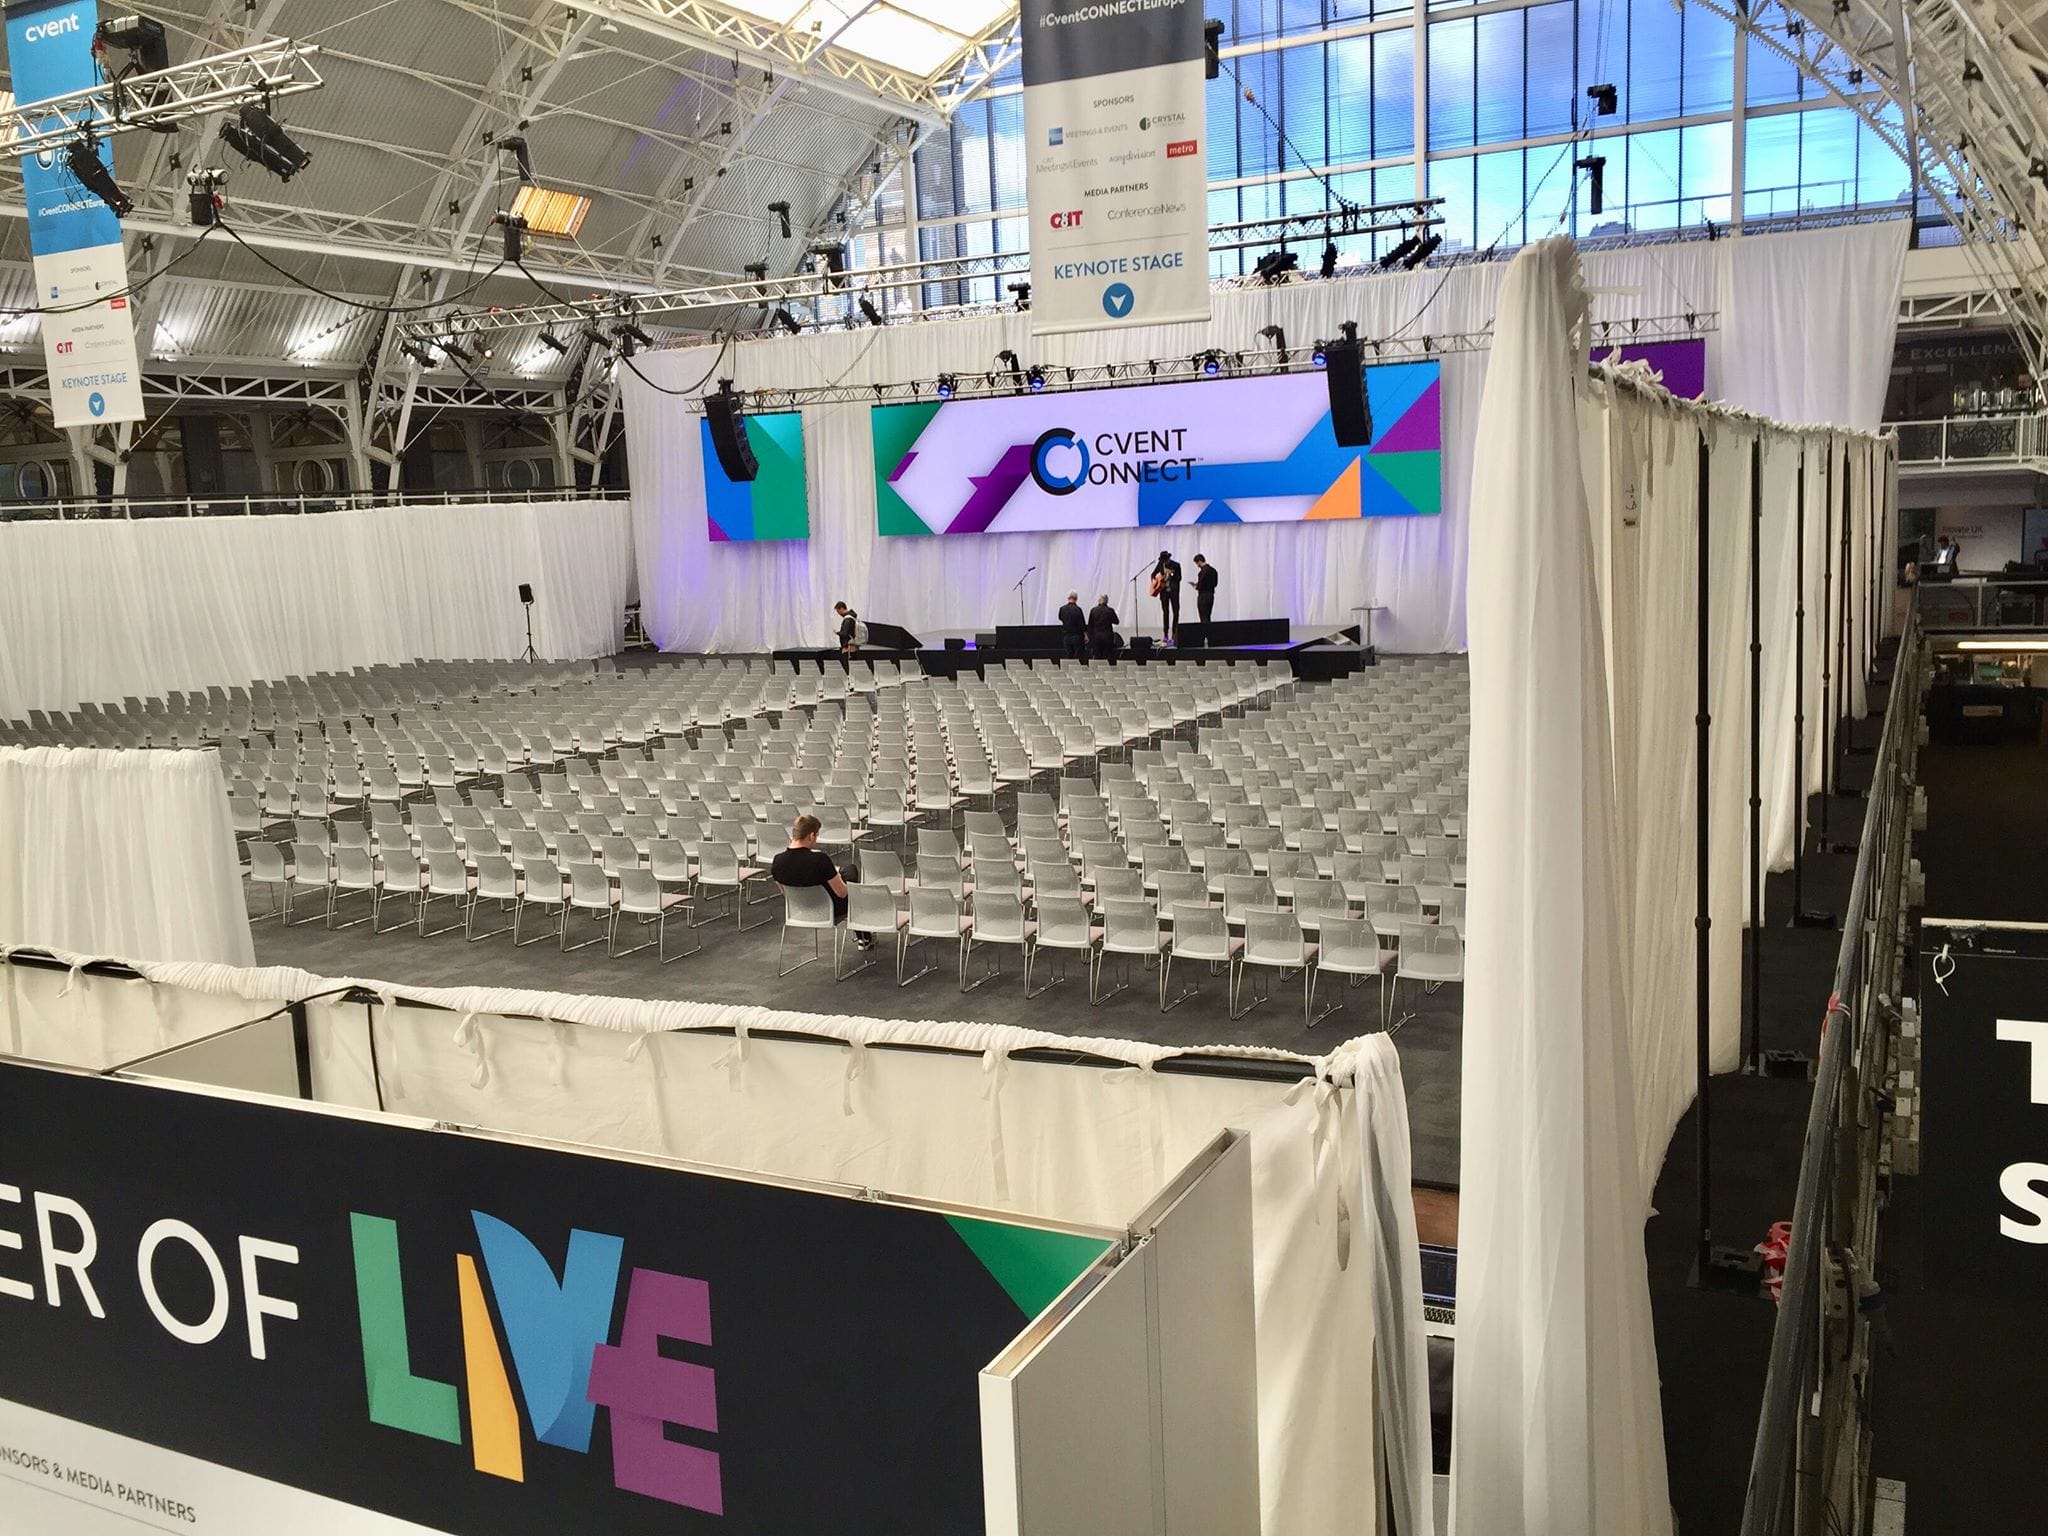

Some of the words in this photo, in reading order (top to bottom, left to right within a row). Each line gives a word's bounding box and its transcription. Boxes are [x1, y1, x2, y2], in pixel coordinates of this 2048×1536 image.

[25, 13, 80, 42] cvent
[1093, 95, 1134, 109] SPONSORS
[1152, 113, 1186, 124] CRYSTAL
[1169, 145, 1195, 156] metro
[1084, 187, 1109, 198] MEDIA
[1110, 182, 1149, 195] PARTNERS
[1054, 258, 1127, 280] KEYNOTE
[1133, 251, 1184, 272] STAGE
[62, 375, 99, 389] KEYNOTE
[101, 372, 128, 385] STAGE
[1095, 428, 1187, 456] CVENT
[138, 1218, 299, 1360] OF
[349, 1208, 724, 1516] LIVE
[0, 1446, 49, 1475] NSORS
[53, 1462, 63, 1479] &
[66, 1467, 114, 1497] MEDIA
[118, 1483, 197, 1523] PARTNERS
